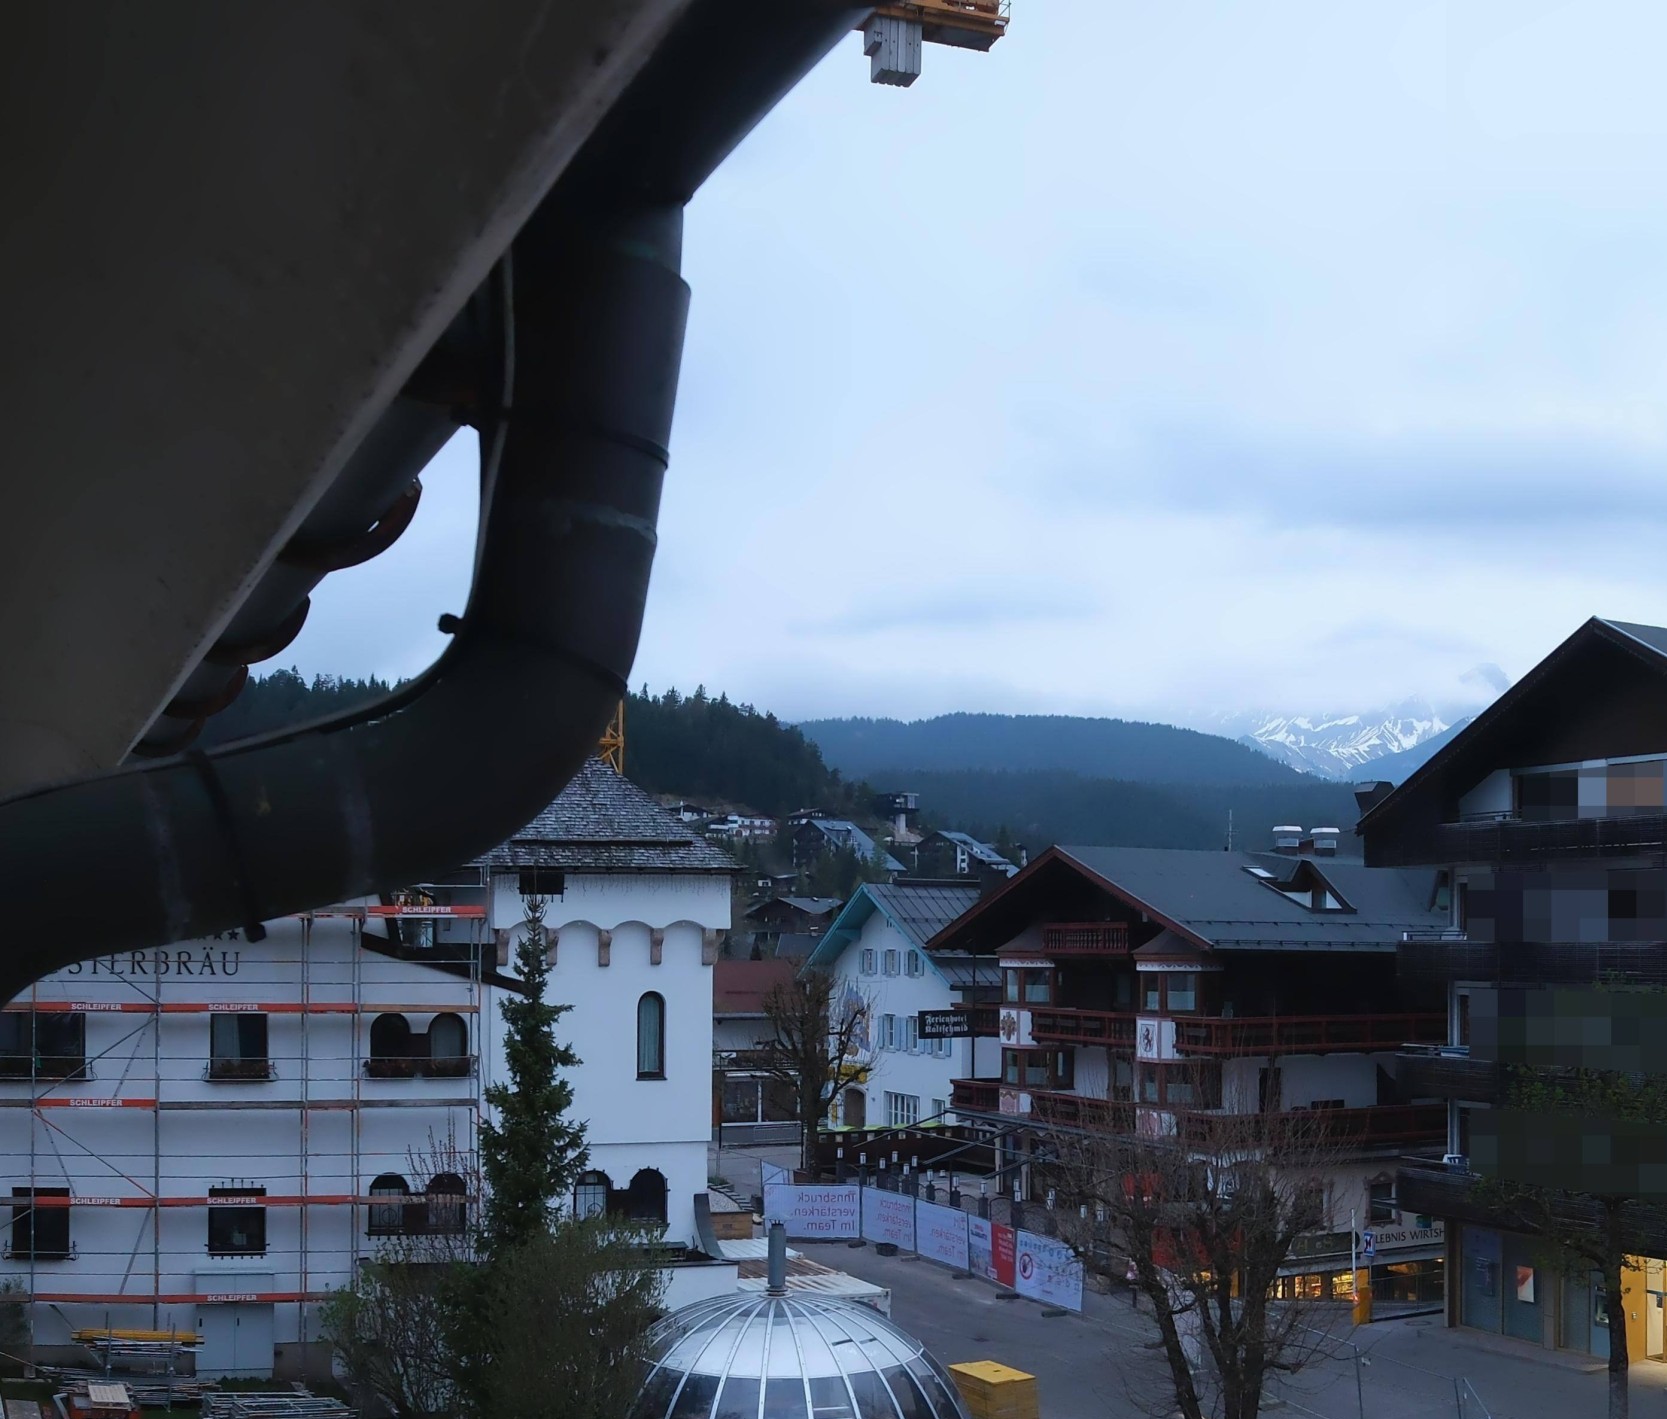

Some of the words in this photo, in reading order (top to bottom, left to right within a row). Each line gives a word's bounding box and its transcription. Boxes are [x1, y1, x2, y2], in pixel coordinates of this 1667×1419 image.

[402, 906, 452, 914] SCHLEIPFER
[46, 946, 241, 977] STERBRÄU
[71, 1003, 122, 1011] SCHLEIPFER
[208, 1003, 259, 1011] SCHLEIPFER
[70, 1099, 123, 1107] SCHLEIPFER
[70, 1198, 121, 1206] SCHLEIPFER
[206, 1197, 257, 1205] SCHLEIPFER
[207, 1294, 257, 1302] SCHLEIPFER
